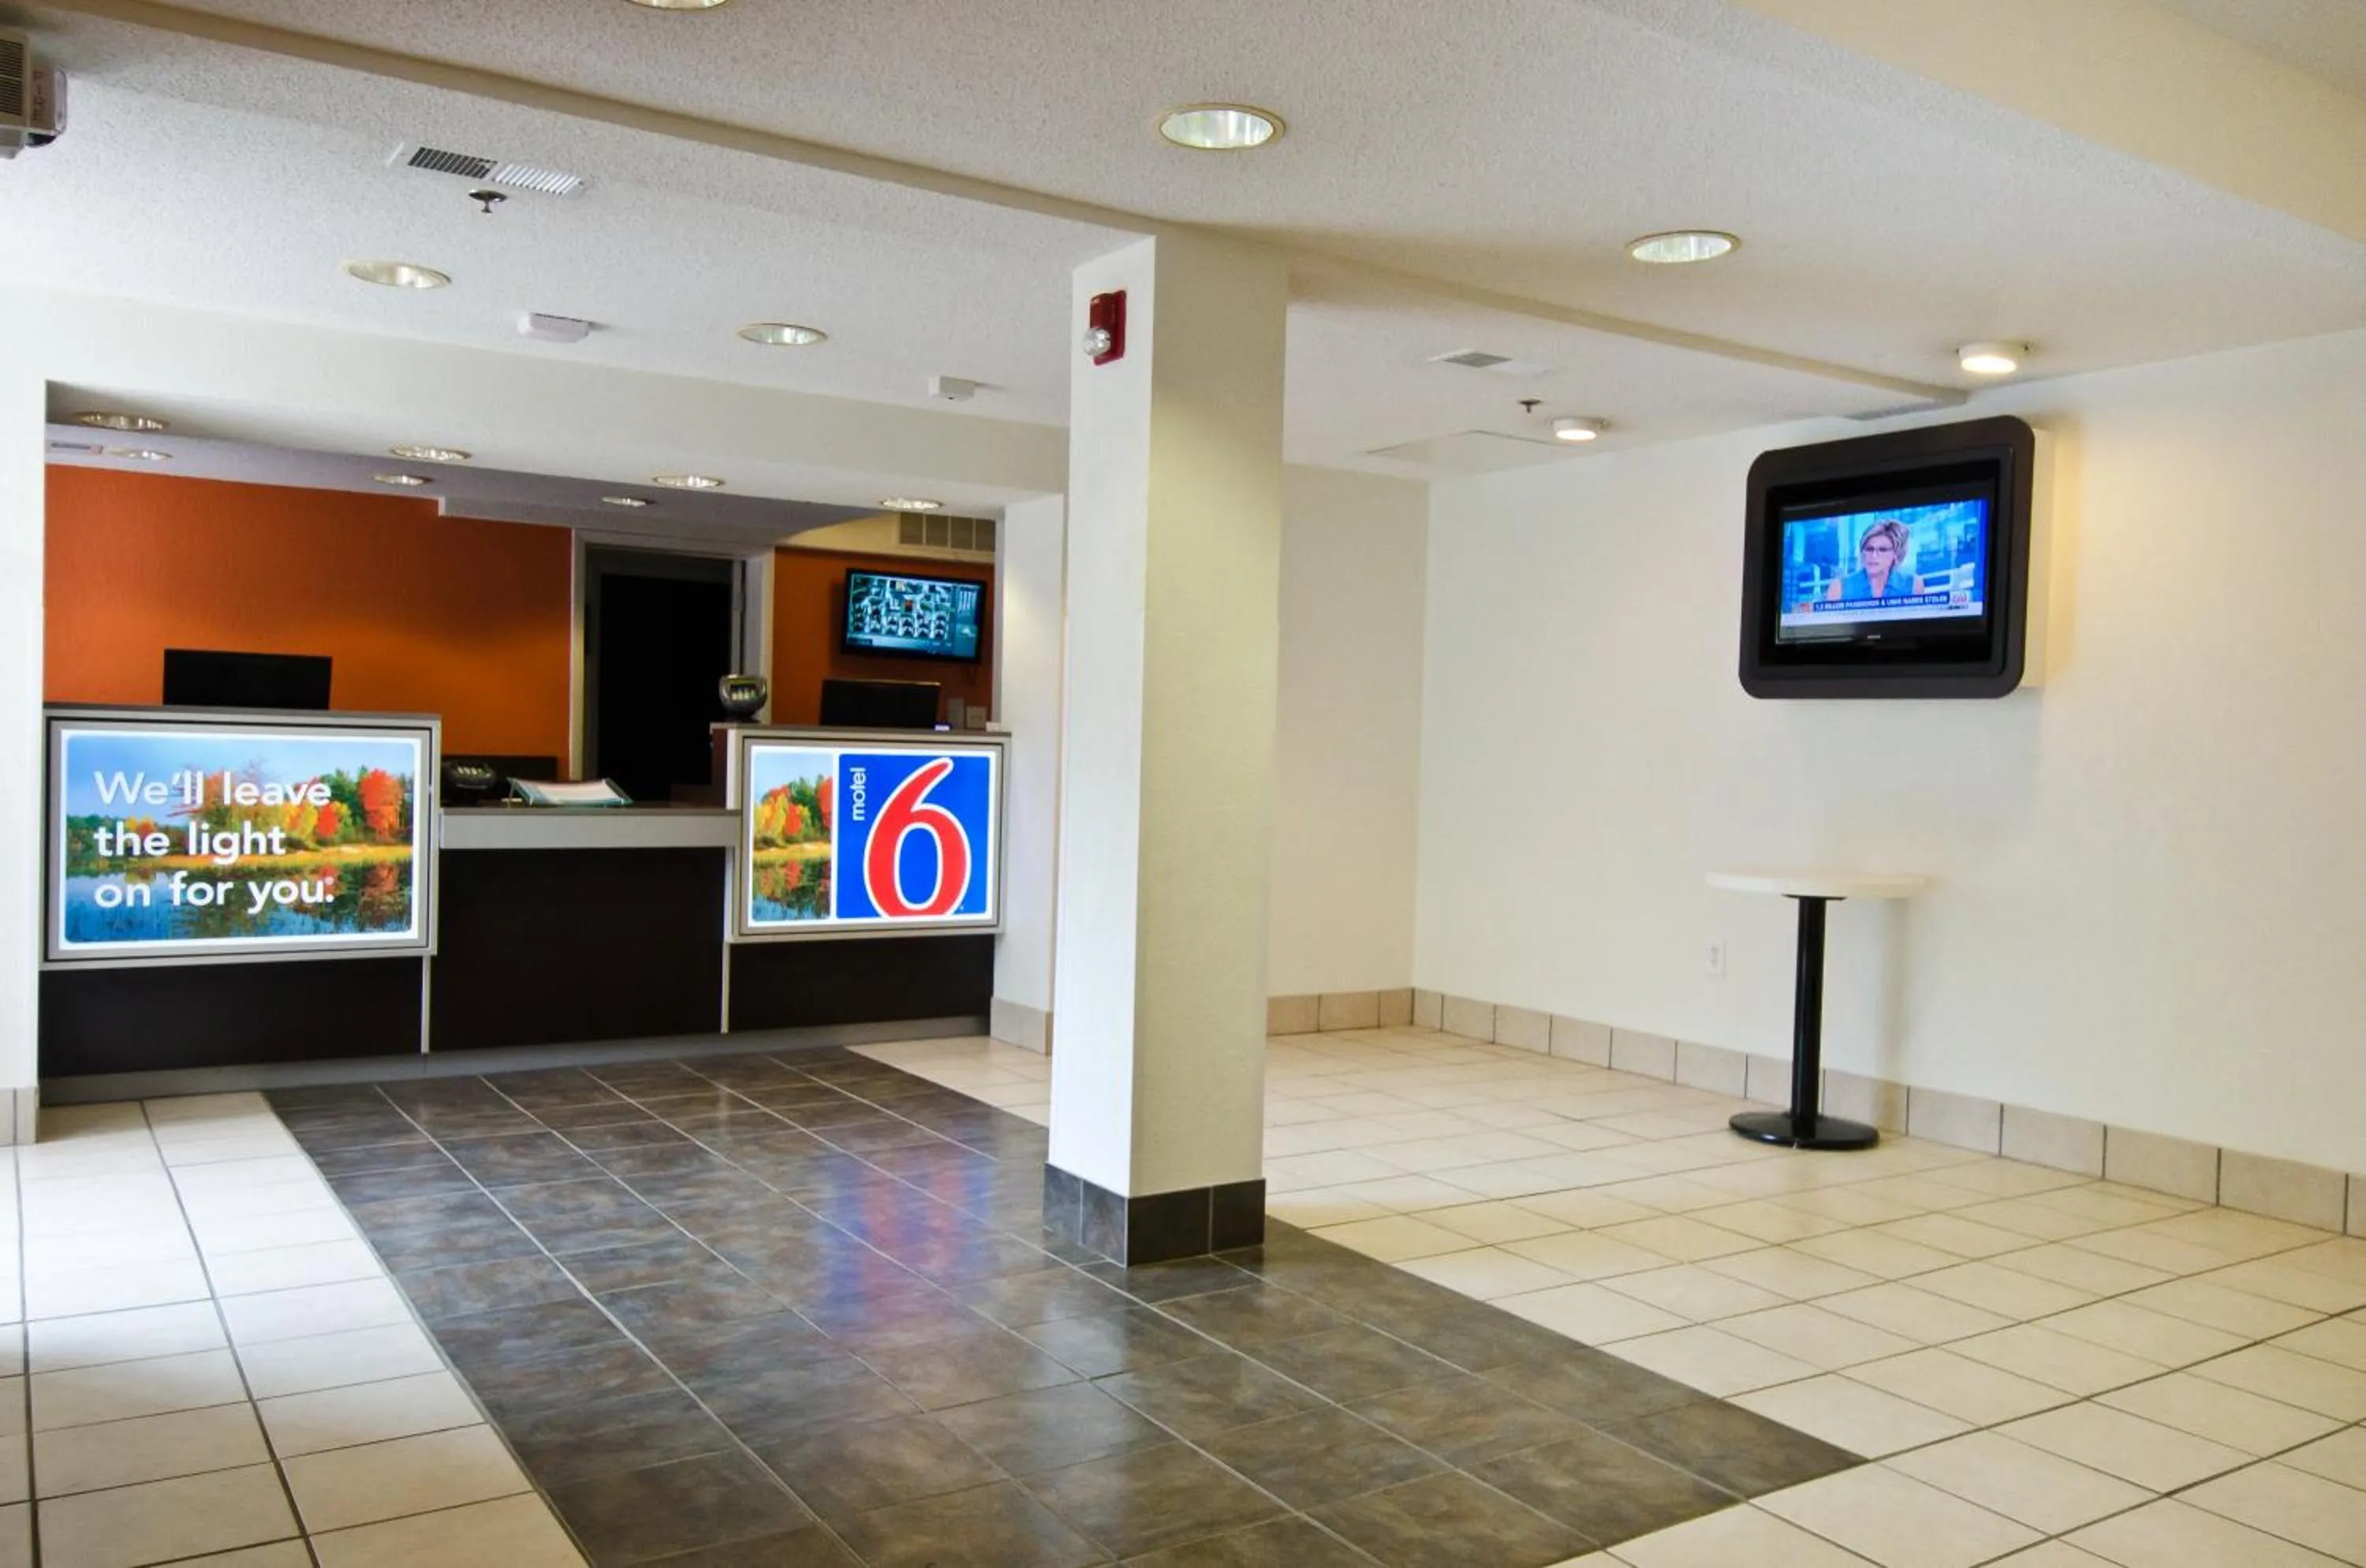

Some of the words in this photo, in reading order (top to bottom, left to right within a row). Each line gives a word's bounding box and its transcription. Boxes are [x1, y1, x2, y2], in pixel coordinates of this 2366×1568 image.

[223, 770, 332, 806] leave
[849, 767, 866, 821] motel
[93, 820, 170, 857] the
[188, 819, 285, 865] light
[864, 757, 971, 917] 6
[94, 883, 150, 908] on
[169, 871, 233, 907] for
